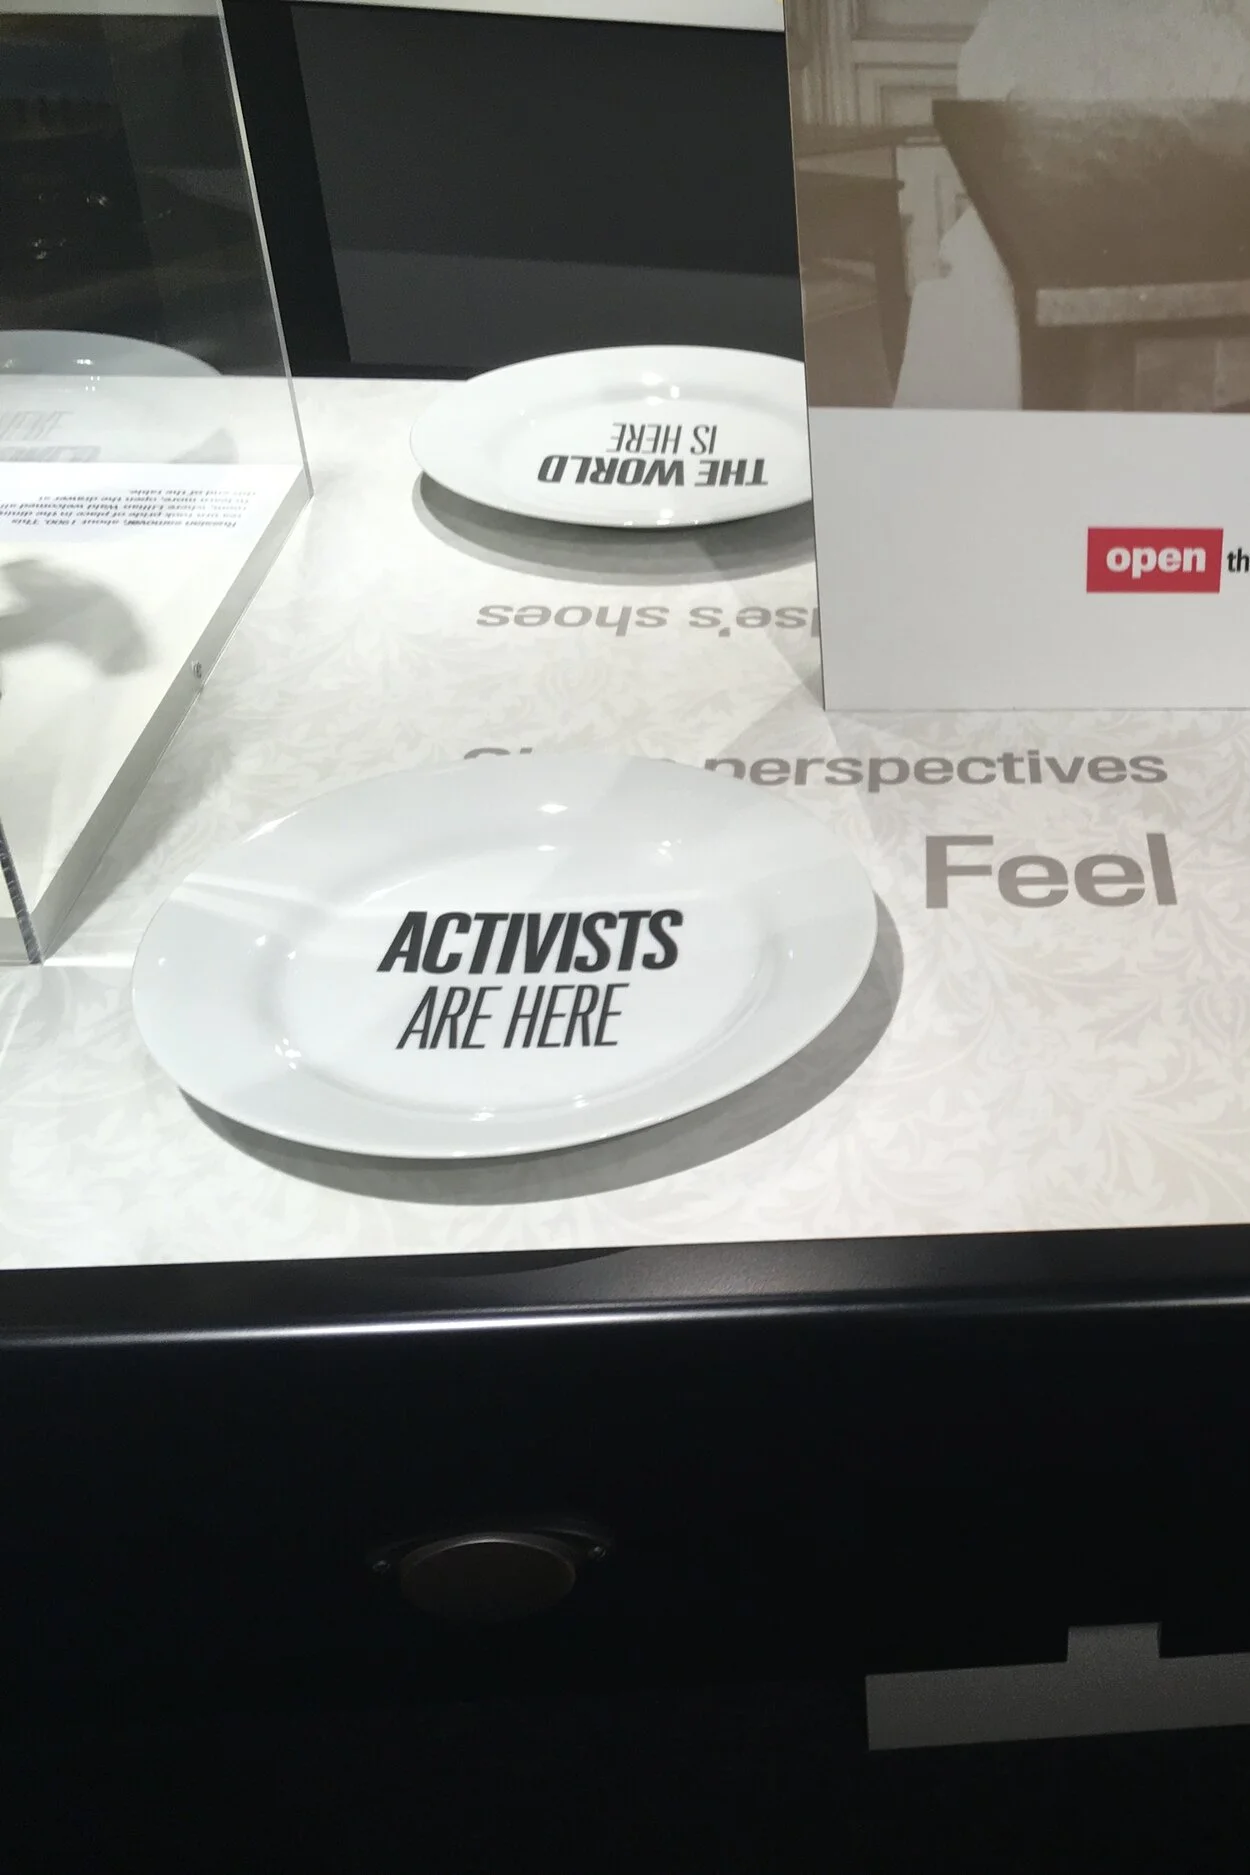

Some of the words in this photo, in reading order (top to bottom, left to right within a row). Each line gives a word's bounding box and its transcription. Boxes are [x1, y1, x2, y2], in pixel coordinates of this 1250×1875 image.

[606, 422, 682, 455] HERE
[690, 424, 717, 455] IS
[537, 455, 684, 487] WORLD
[694, 457, 768, 487] THE
[1105, 546, 1207, 579] open
[476, 604, 670, 637] shoes
[924, 832, 1178, 909] Feel
[376, 908, 684, 975] ACTIVISTS
[395, 985, 503, 1050] ARE
[503, 982, 630, 1049] HERE
